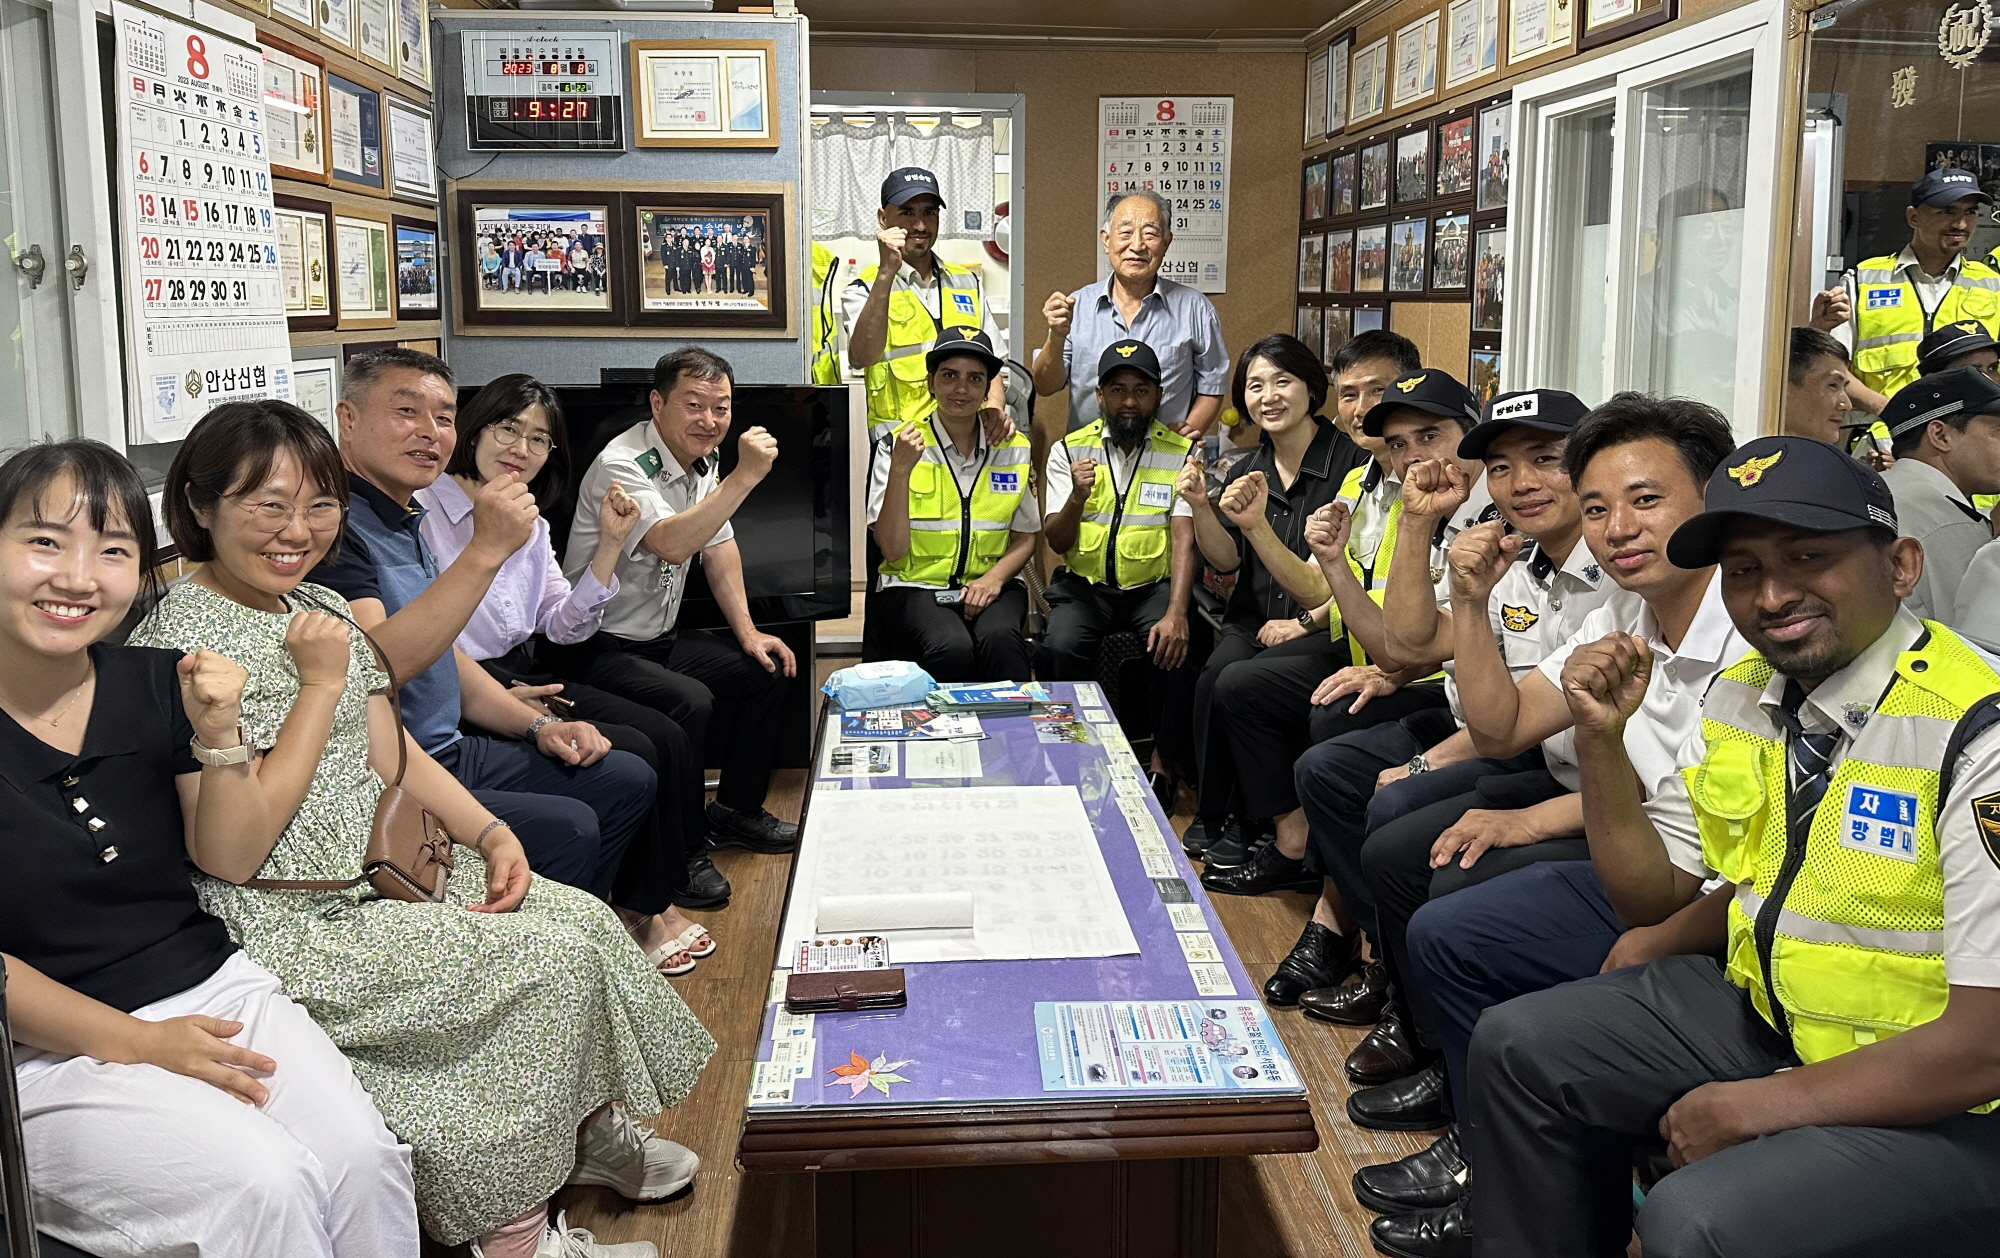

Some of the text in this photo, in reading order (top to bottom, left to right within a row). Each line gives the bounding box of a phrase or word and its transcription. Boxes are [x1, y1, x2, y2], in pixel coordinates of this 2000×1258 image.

[187, 35, 210, 80] 8
[504, 63, 532, 73] 2023
[550, 64, 557, 73] 8
[578, 64, 584, 73] 8
[178, 76, 190, 86] 2023
[190, 79, 210, 90] AUGUST
[133, 77, 258, 122] 日 月 火 水 木 金 土
[529, 102, 587, 118] 9:27
[1156, 100, 1175, 121] 8
[180, 119, 186, 140] 1
[201, 123, 210, 144] 2
[221, 127, 229, 147] 3
[239, 132, 245, 151] 4
[253, 135, 261, 154] 5
[1146, 143, 1219, 152] 1 2 3 4 5
[139, 152, 267, 191] 6 7 8 9 10 11 12
[1110, 162, 1221, 172] 6 7 8 9 10 11 12
[1107, 180, 1221, 191] 13 14 15 16 17 18 19
[139, 194, 271, 227] 13 14 15 16 17 18 19
[1176, 199, 1221, 209] 24 25 26
[1176, 218, 1188, 228] 31
[141, 237, 276, 264] 20 21 22 23 24 25 26
[1161, 261, 1198, 273] 산신협
[145, 279, 162, 300] 27
[168, 280, 185, 300] 28
[190, 280, 206, 300] 29
[211, 281, 227, 300] 30
[233, 281, 246, 300] 31
[206, 365, 266, 393] 안산신협
[1496, 400, 1533, 416] 방범순찰
